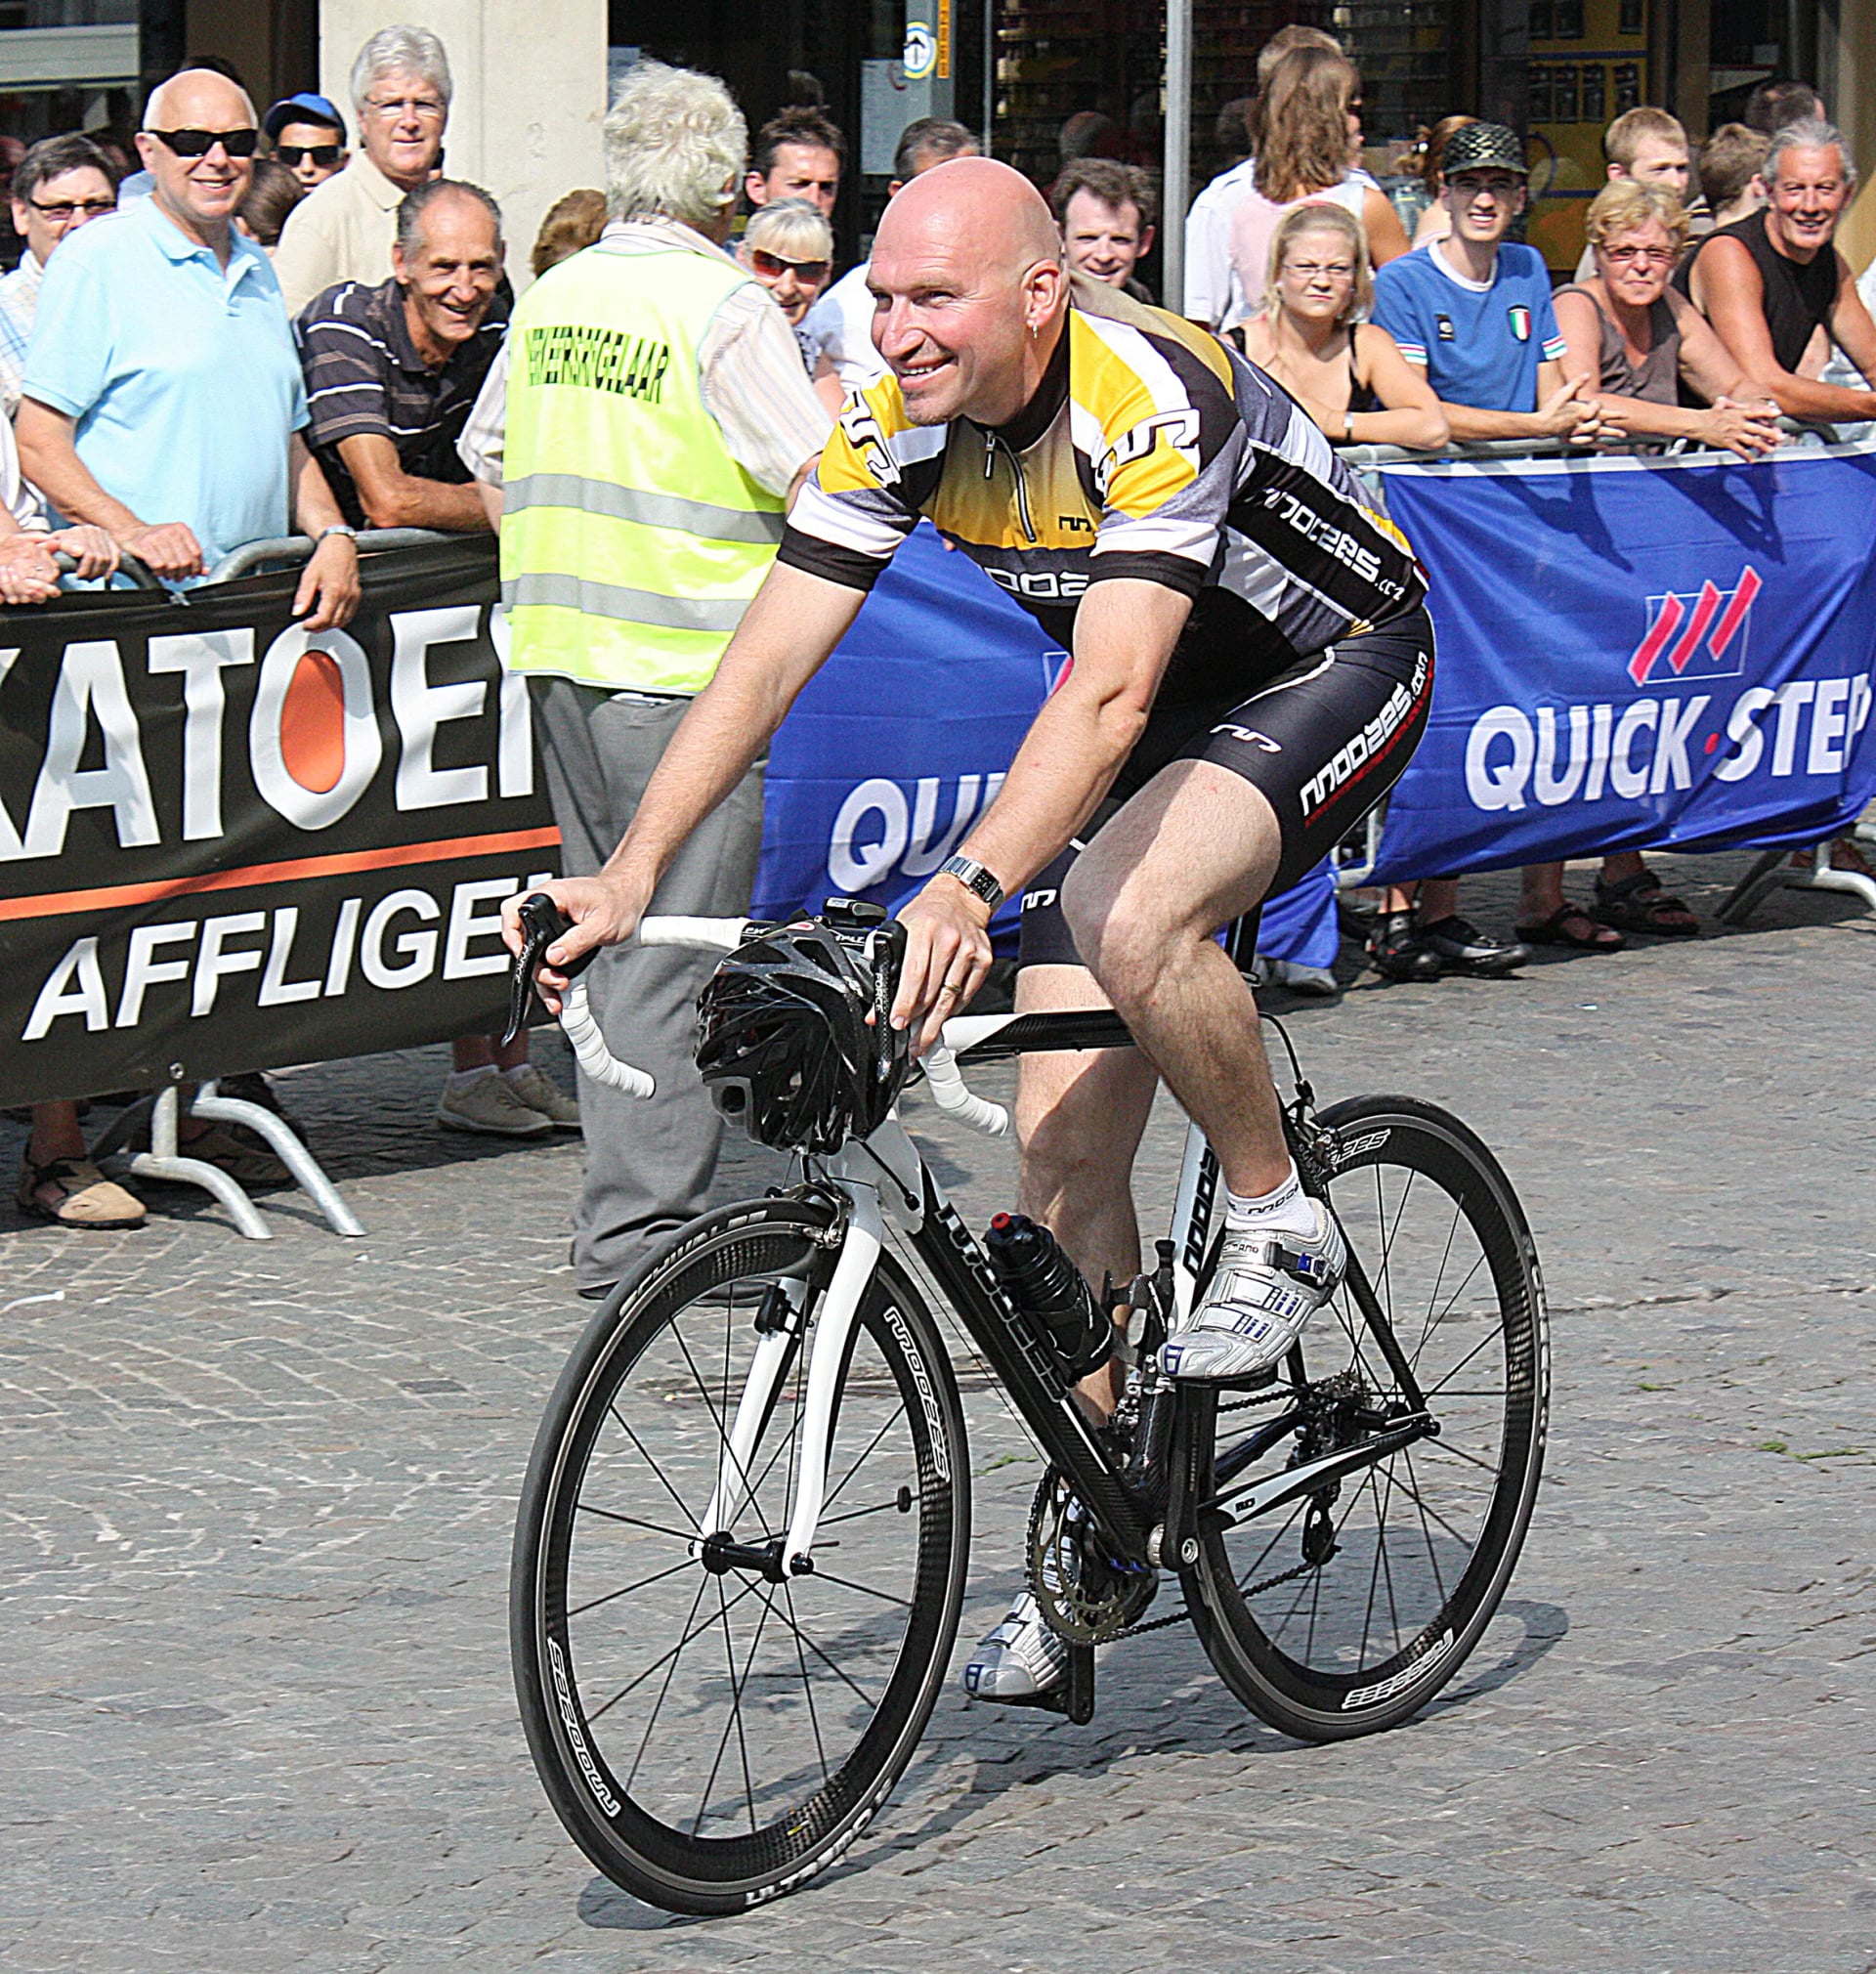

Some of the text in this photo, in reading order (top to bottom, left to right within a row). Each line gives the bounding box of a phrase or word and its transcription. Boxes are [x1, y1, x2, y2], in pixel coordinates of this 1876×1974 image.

[0, 603, 533, 862] ATOE
[1466, 672, 1872, 812] QUICK STEP
[21, 872, 553, 1042] AFFLIGE
[874, 971, 884, 1013] FORCE
